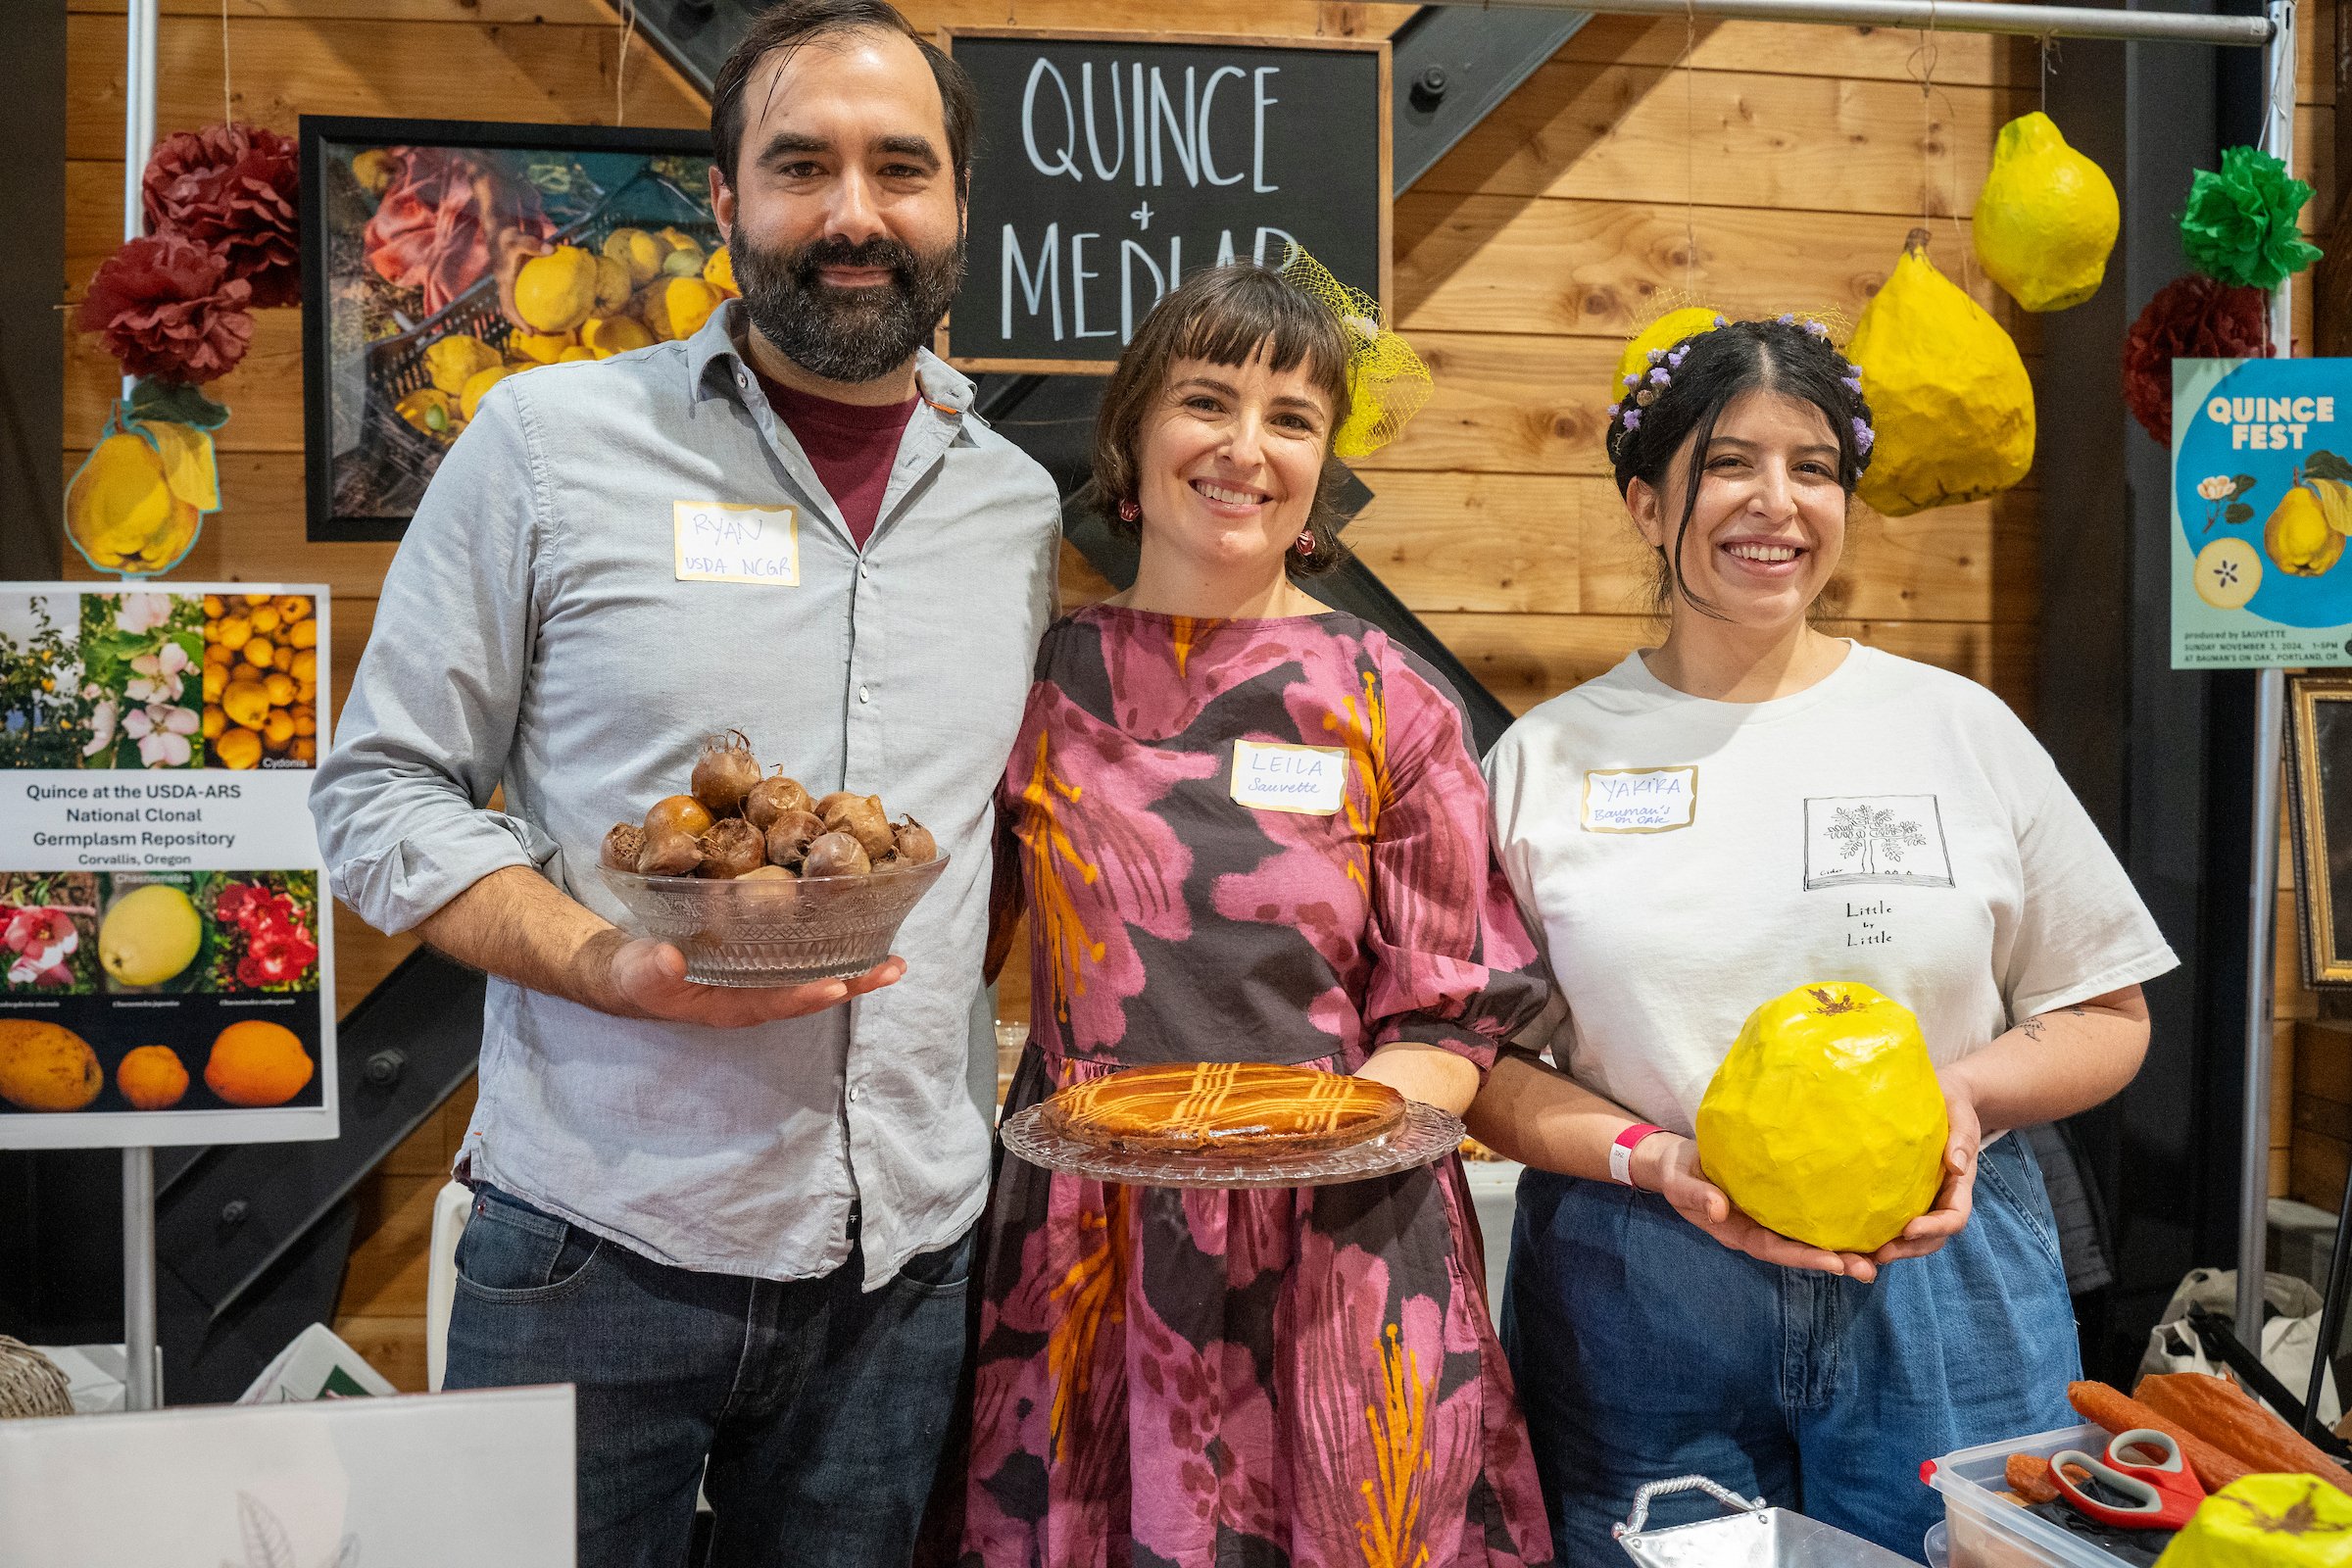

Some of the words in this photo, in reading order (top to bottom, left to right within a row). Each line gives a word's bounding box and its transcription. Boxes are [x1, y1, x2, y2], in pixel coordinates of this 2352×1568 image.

[1021, 57, 1280, 193] QUINCE
[2207, 396, 2334, 425] QUINCE
[2232, 423, 2308, 450] FEST
[693, 514, 762, 546] RYAN
[685, 557, 727, 573] USDA
[742, 557, 791, 576] NCGR
[2184, 631, 2226, 640] produced
[2229, 631, 2238, 640] by
[2241, 629, 2285, 638] SAUVETTE
[263, 757, 308, 768] Cydonia
[1252, 753, 1322, 776] LEILA
[26, 784, 88, 801] Quince
[92, 785, 110, 799] at
[114, 784, 141, 799] the
[147, 784, 241, 799] USDA-ARS
[1248, 777, 1320, 793] Sauvette
[67, 808, 140, 822] National
[145, 808, 202, 822] Clonal
[33, 832, 136, 847] Germplasm
[141, 832, 235, 848] Repository
[78, 854, 141, 866] Corvallis,
[144, 855, 191, 866] Oregon
[1846, 901, 1892, 918] Little
[1847, 931, 1892, 948] Little
